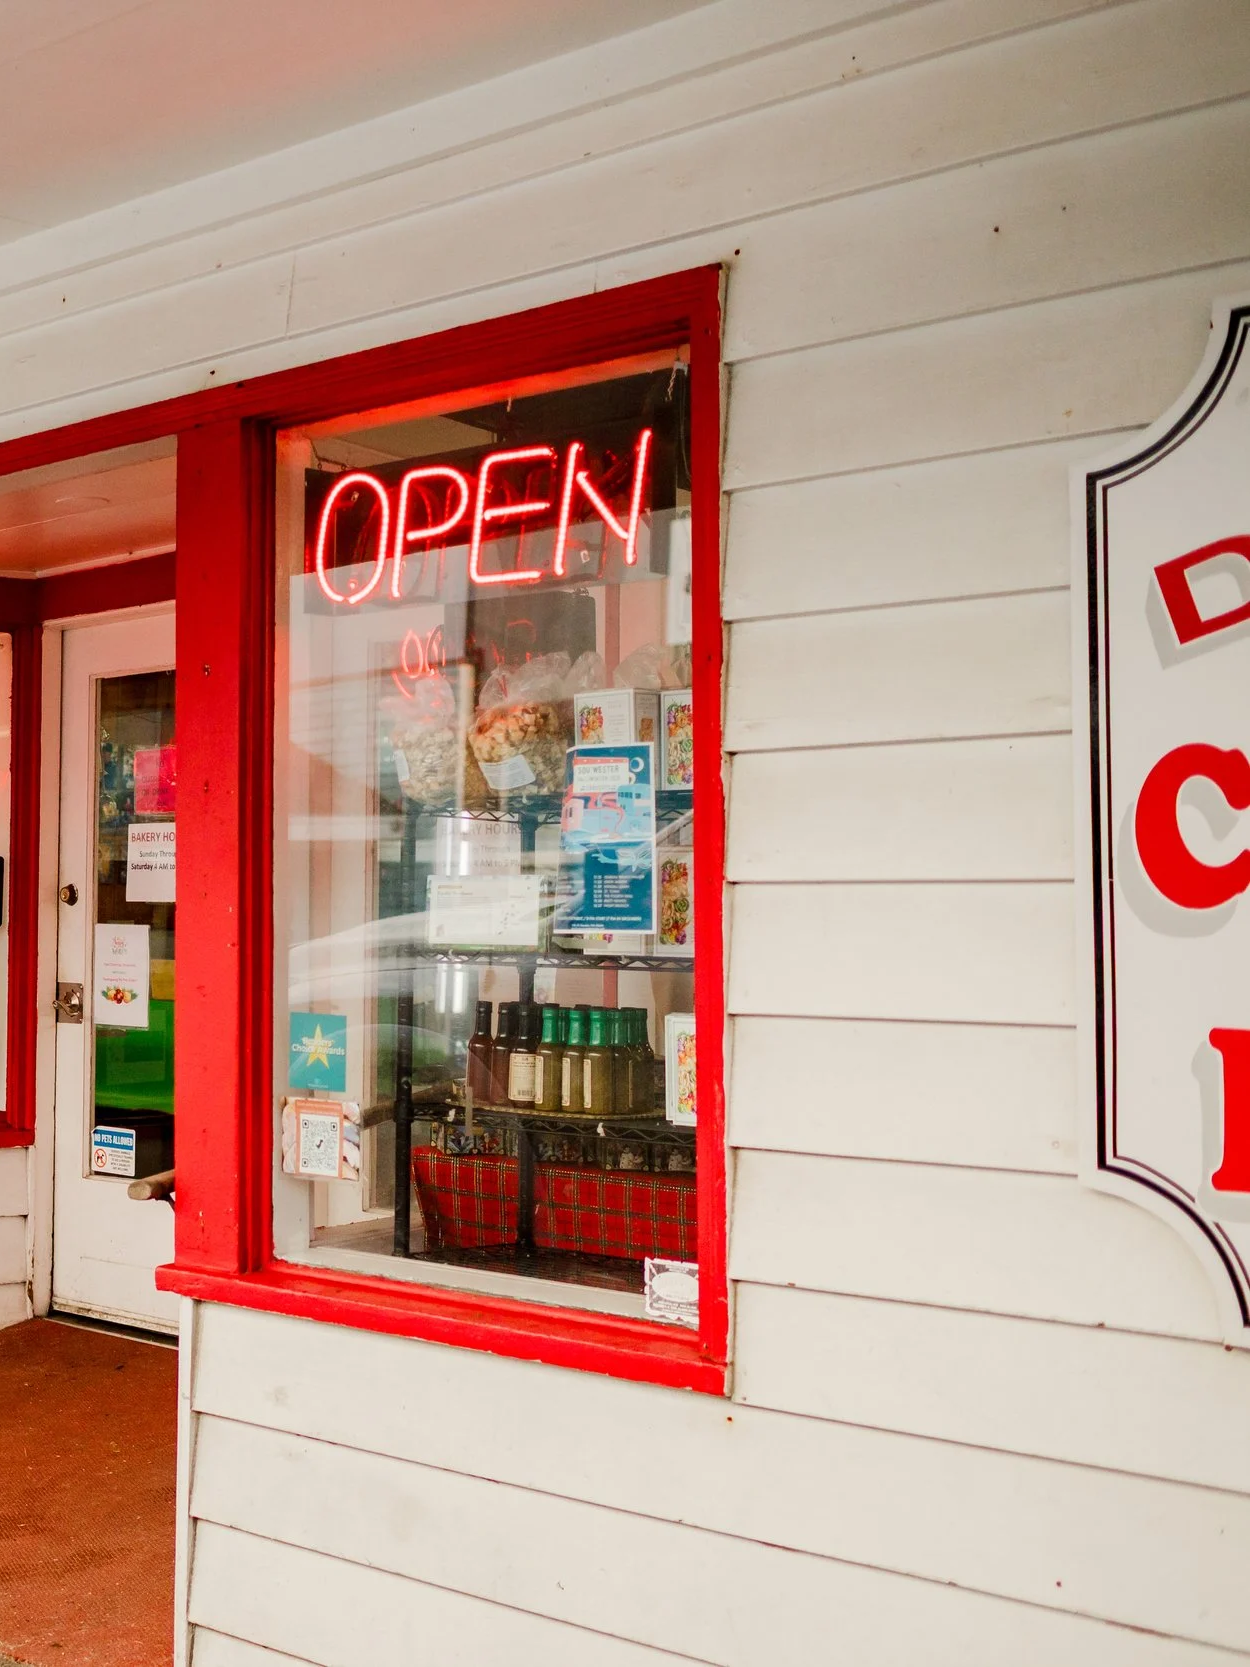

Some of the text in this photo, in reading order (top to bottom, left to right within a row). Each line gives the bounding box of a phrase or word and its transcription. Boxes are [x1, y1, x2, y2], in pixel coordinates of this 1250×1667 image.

[316, 427, 653, 605] OPEN
[131, 832, 162, 843] BAKERY
[139, 850, 158, 859] Sunday
[131, 862, 153, 872] Saturday
[159, 862, 168, 870] AM
[316, 1046, 346, 1056] Awards
[94, 1133, 133, 1147] NO PETS ALLOWED
